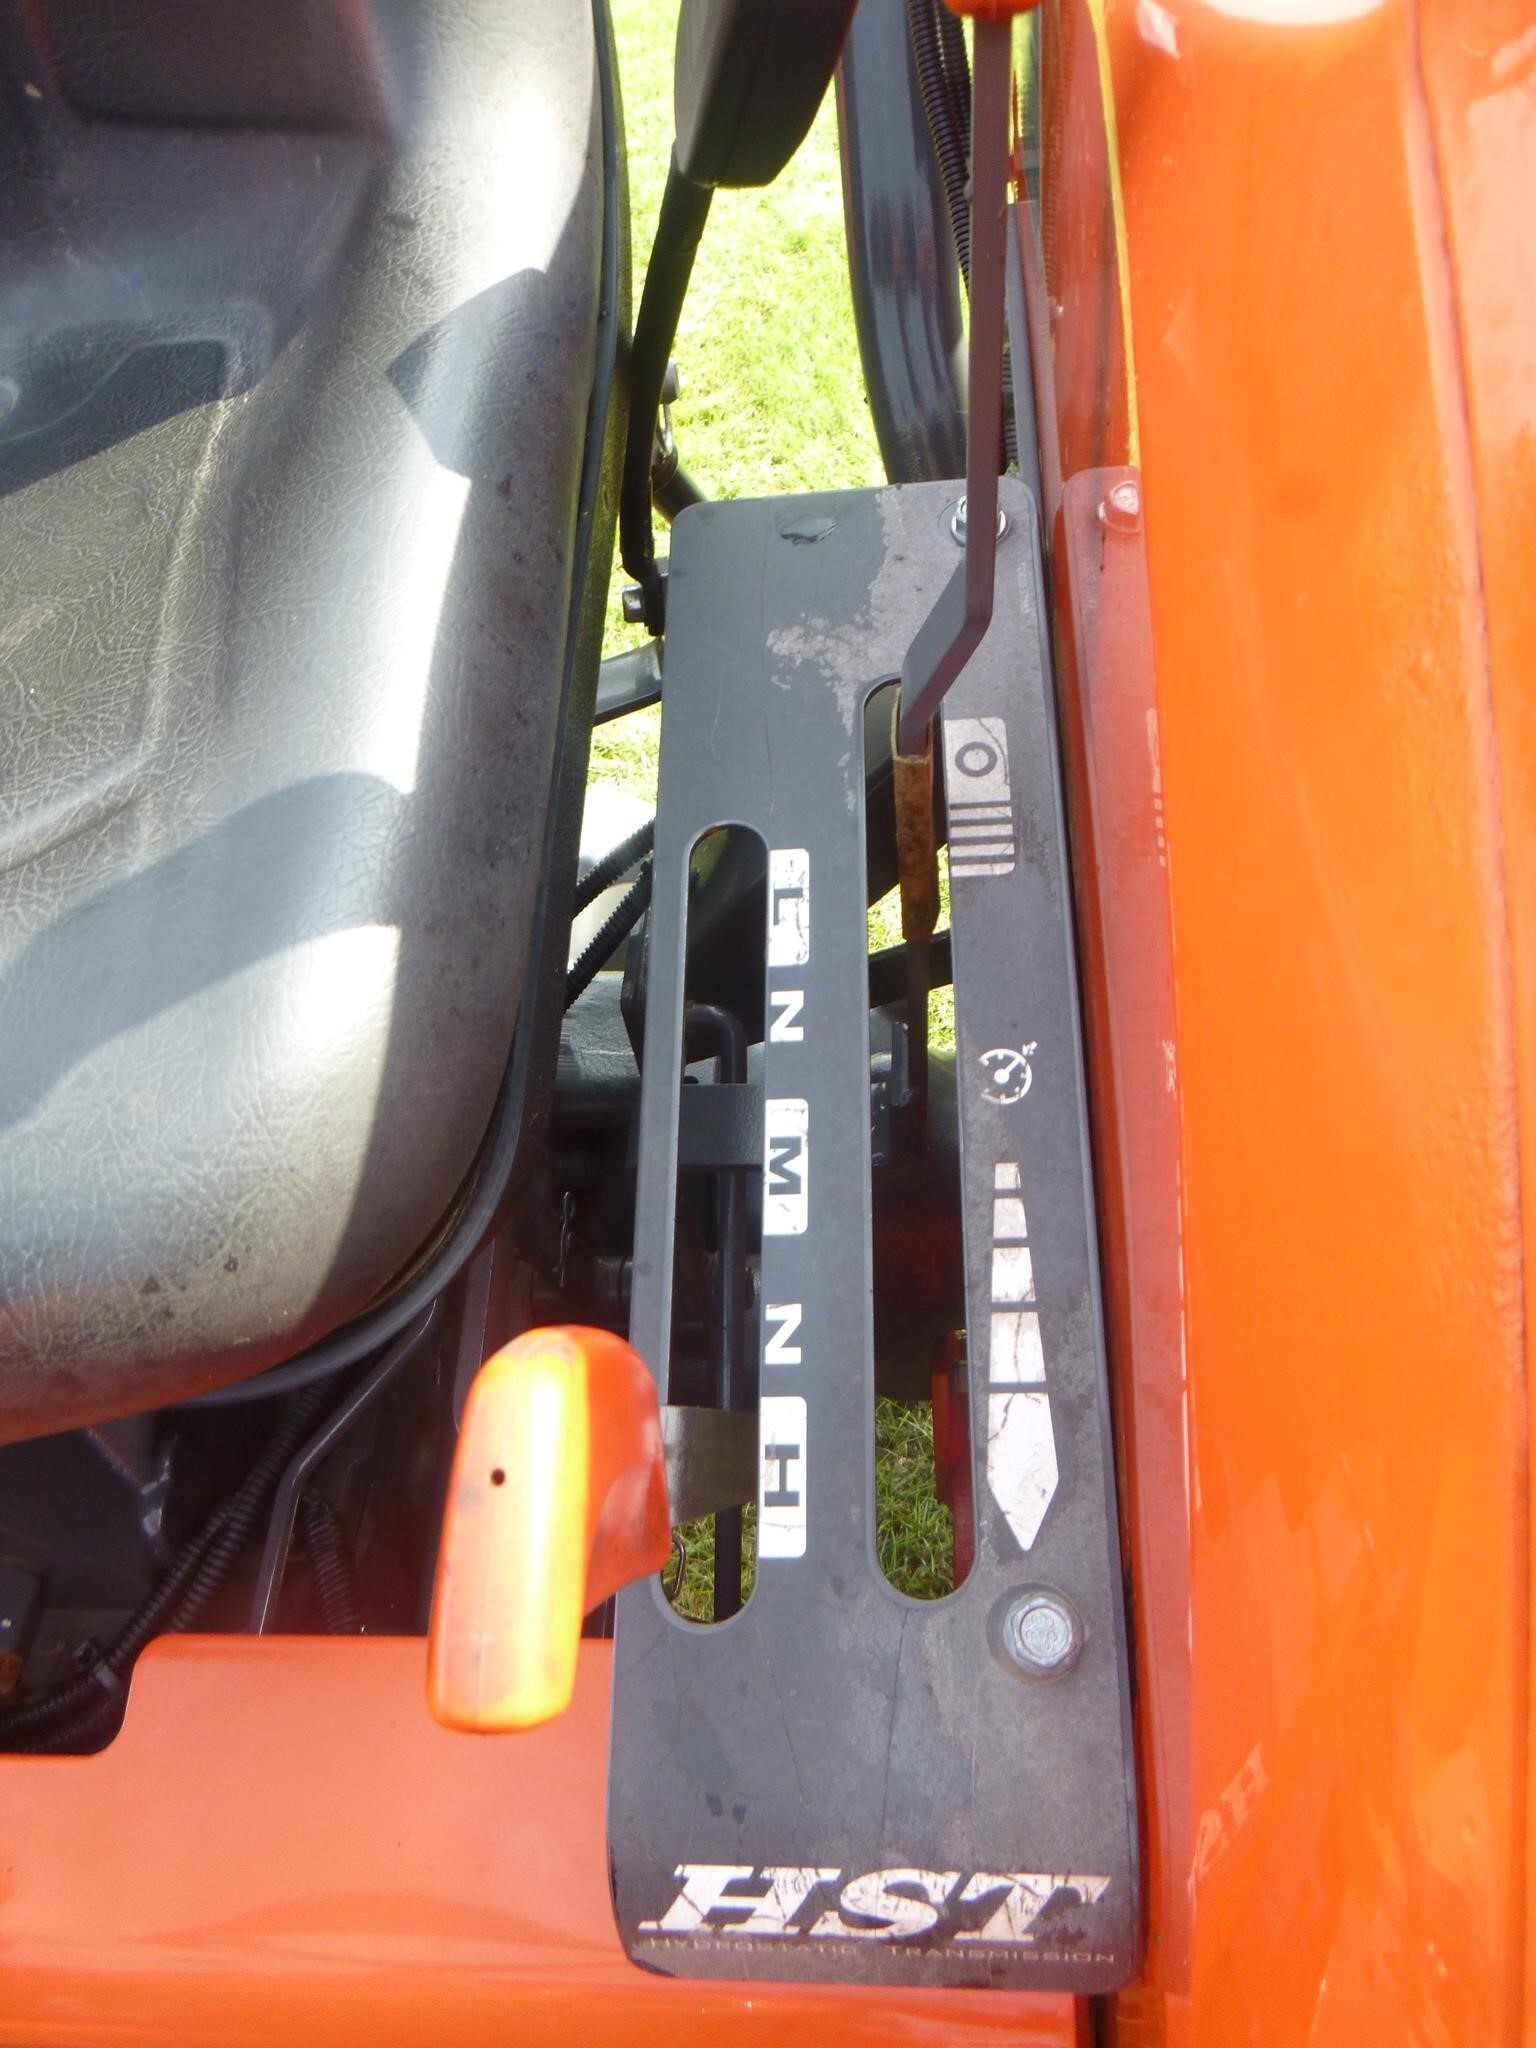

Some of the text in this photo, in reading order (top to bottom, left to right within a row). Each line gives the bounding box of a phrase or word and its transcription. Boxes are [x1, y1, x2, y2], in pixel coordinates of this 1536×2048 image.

[773, 886, 803, 926] L
[769, 1136, 802, 1195] M
[765, 1444, 800, 1507] H
[638, 1863, 1111, 1943] HST
[650, 1937, 1115, 1963] HYDROSTATIC TRANSMISSION
